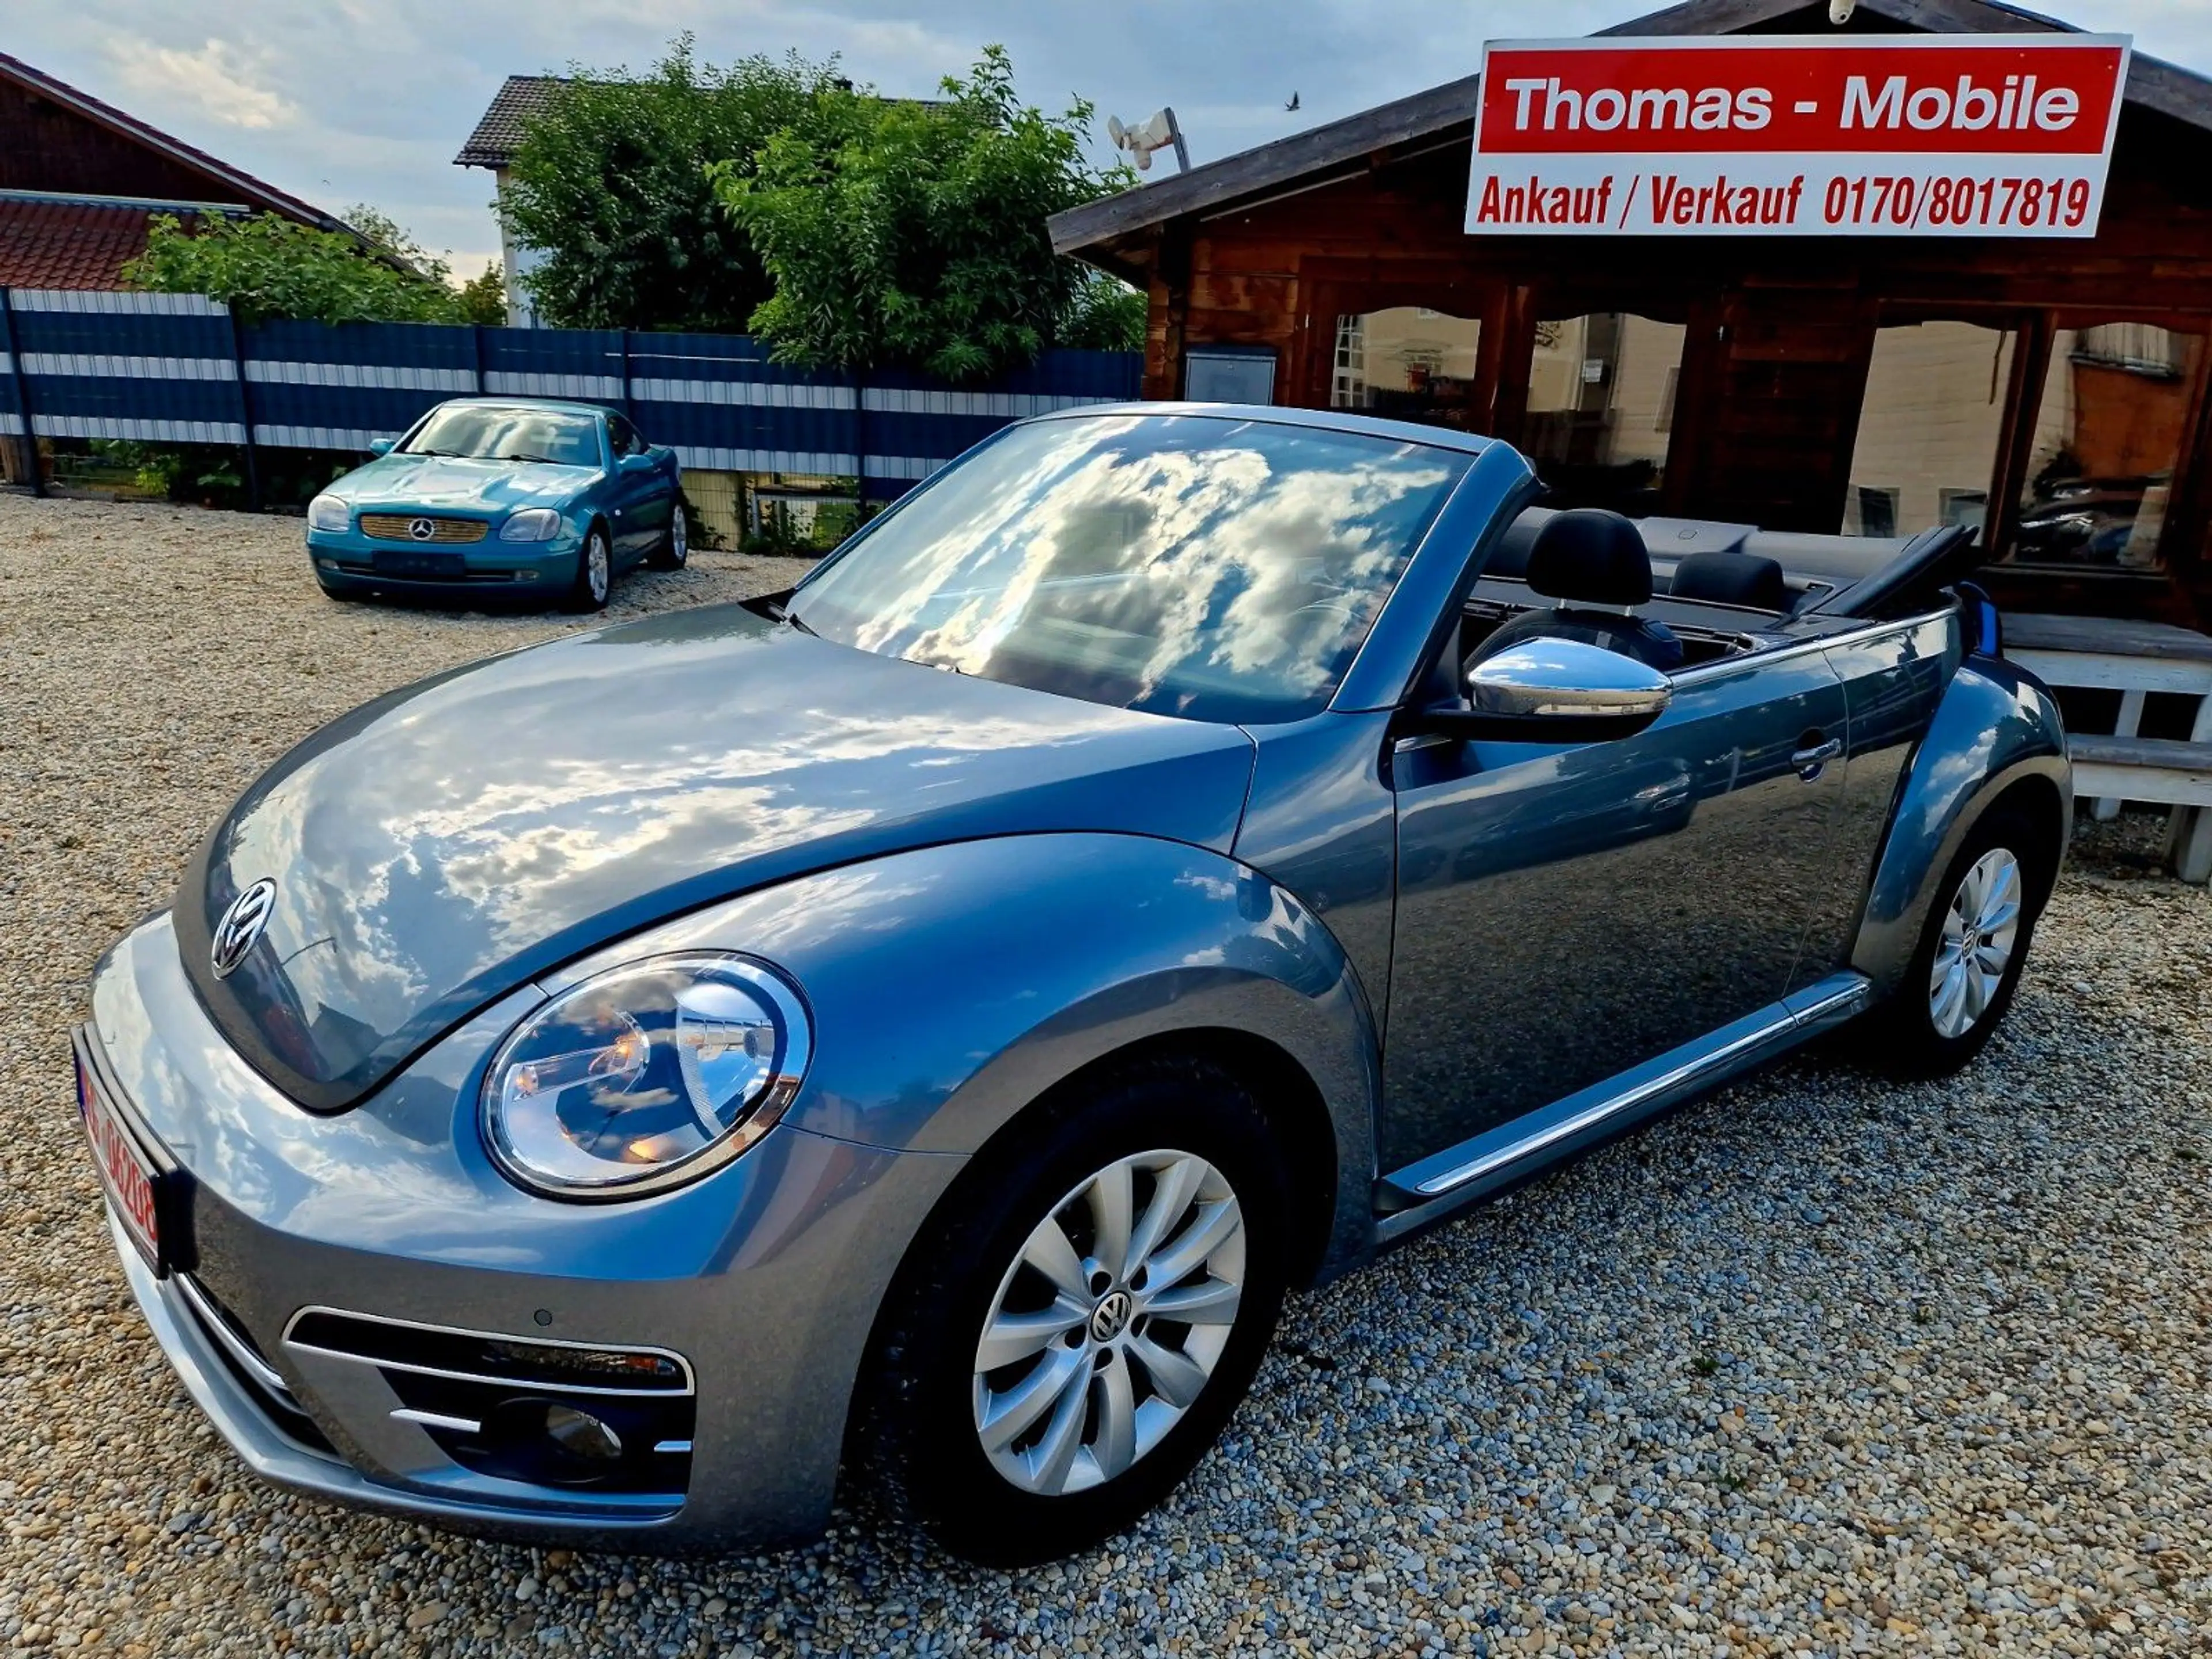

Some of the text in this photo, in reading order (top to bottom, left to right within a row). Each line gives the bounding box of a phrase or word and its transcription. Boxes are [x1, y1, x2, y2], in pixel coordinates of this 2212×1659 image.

[1505, 75, 2080, 131] Thomas - Mobile
[1478, 175, 2090, 229] Ankauf / Verkauf 0170/8017819
